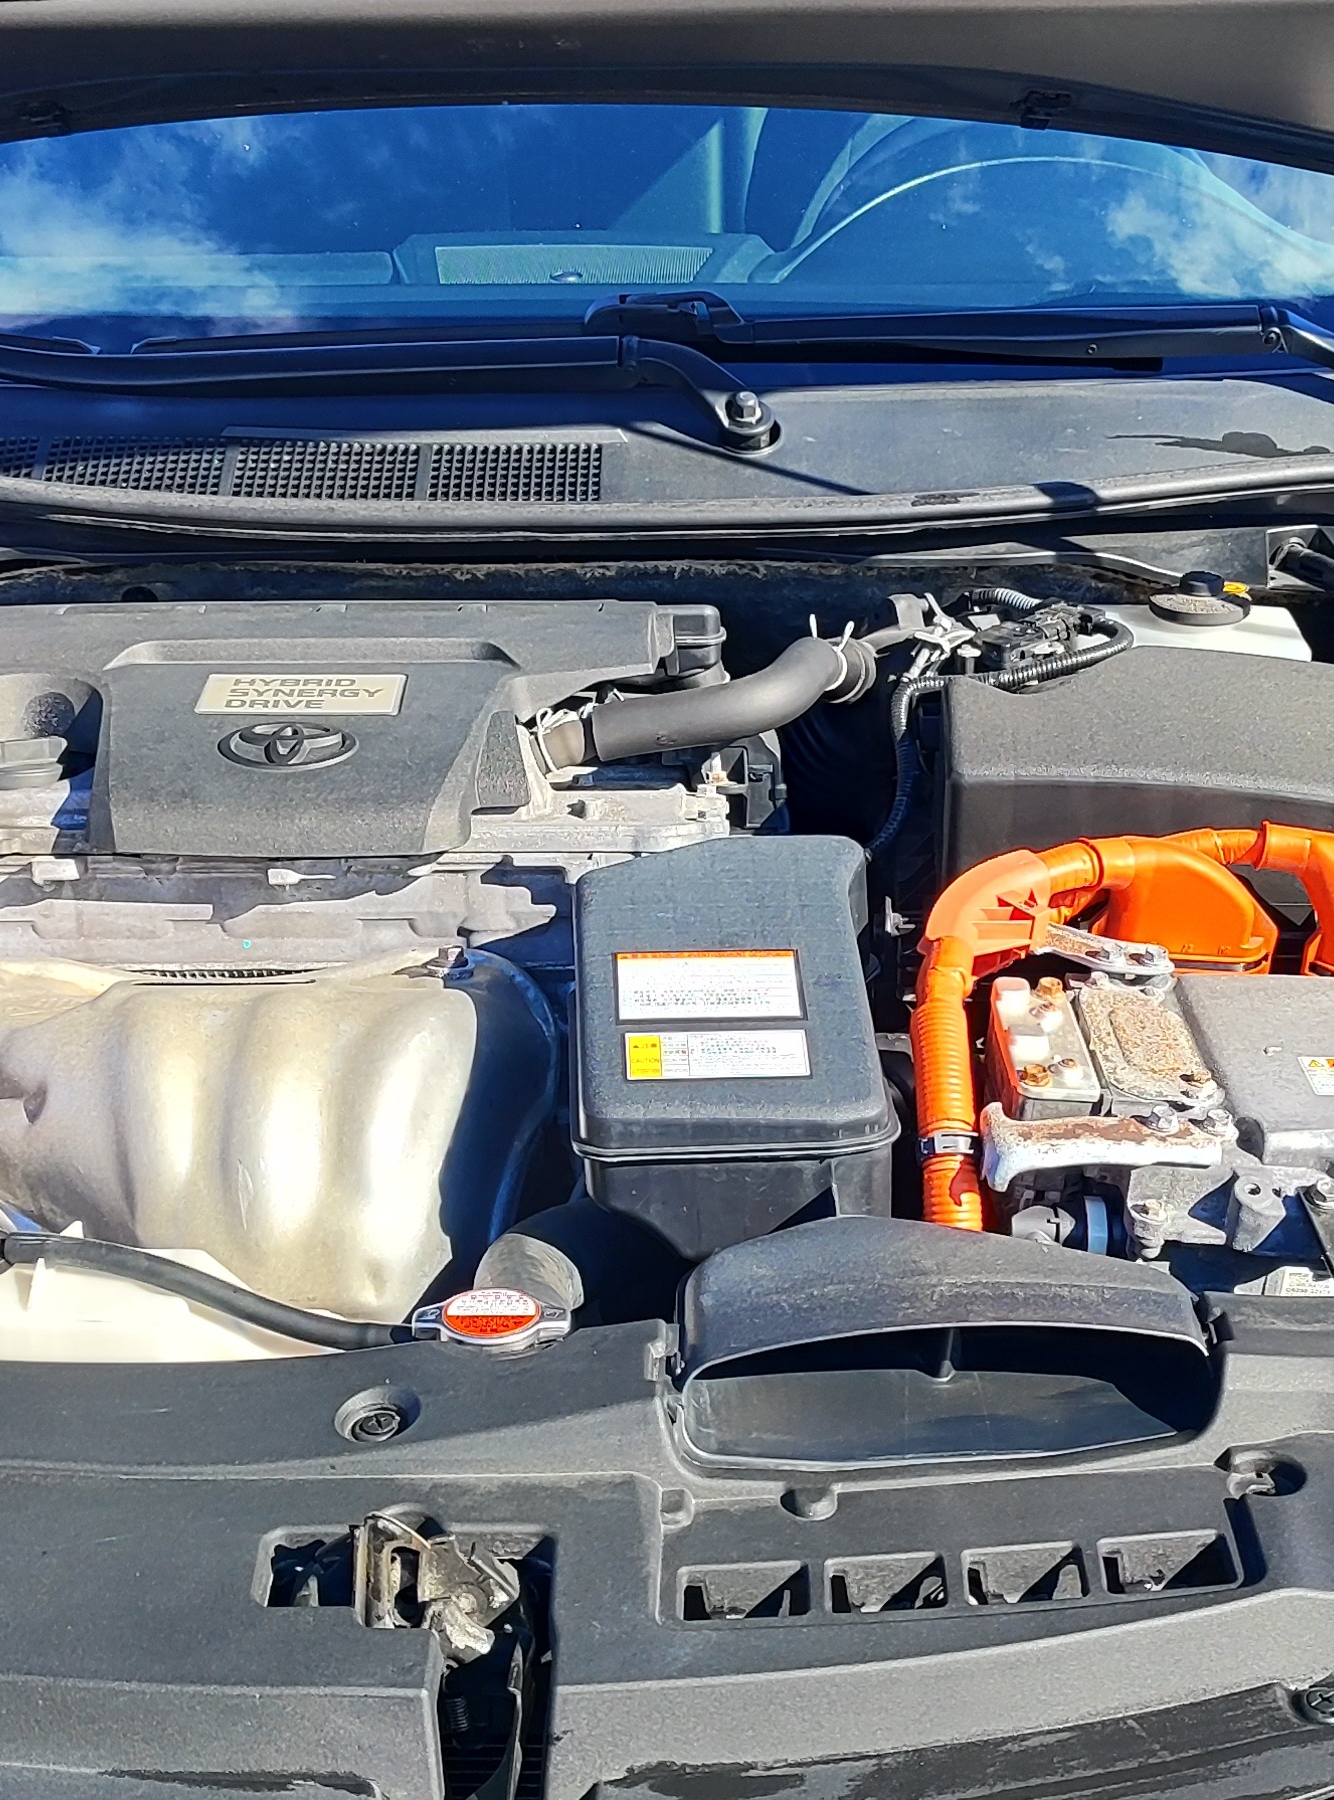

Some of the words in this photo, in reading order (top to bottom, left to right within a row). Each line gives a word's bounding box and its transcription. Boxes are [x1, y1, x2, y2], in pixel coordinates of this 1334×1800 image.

[233, 678, 357, 687] HYBRID
[227, 688, 385, 698] SYNERGY
[224, 699, 326, 709] DRIVE
